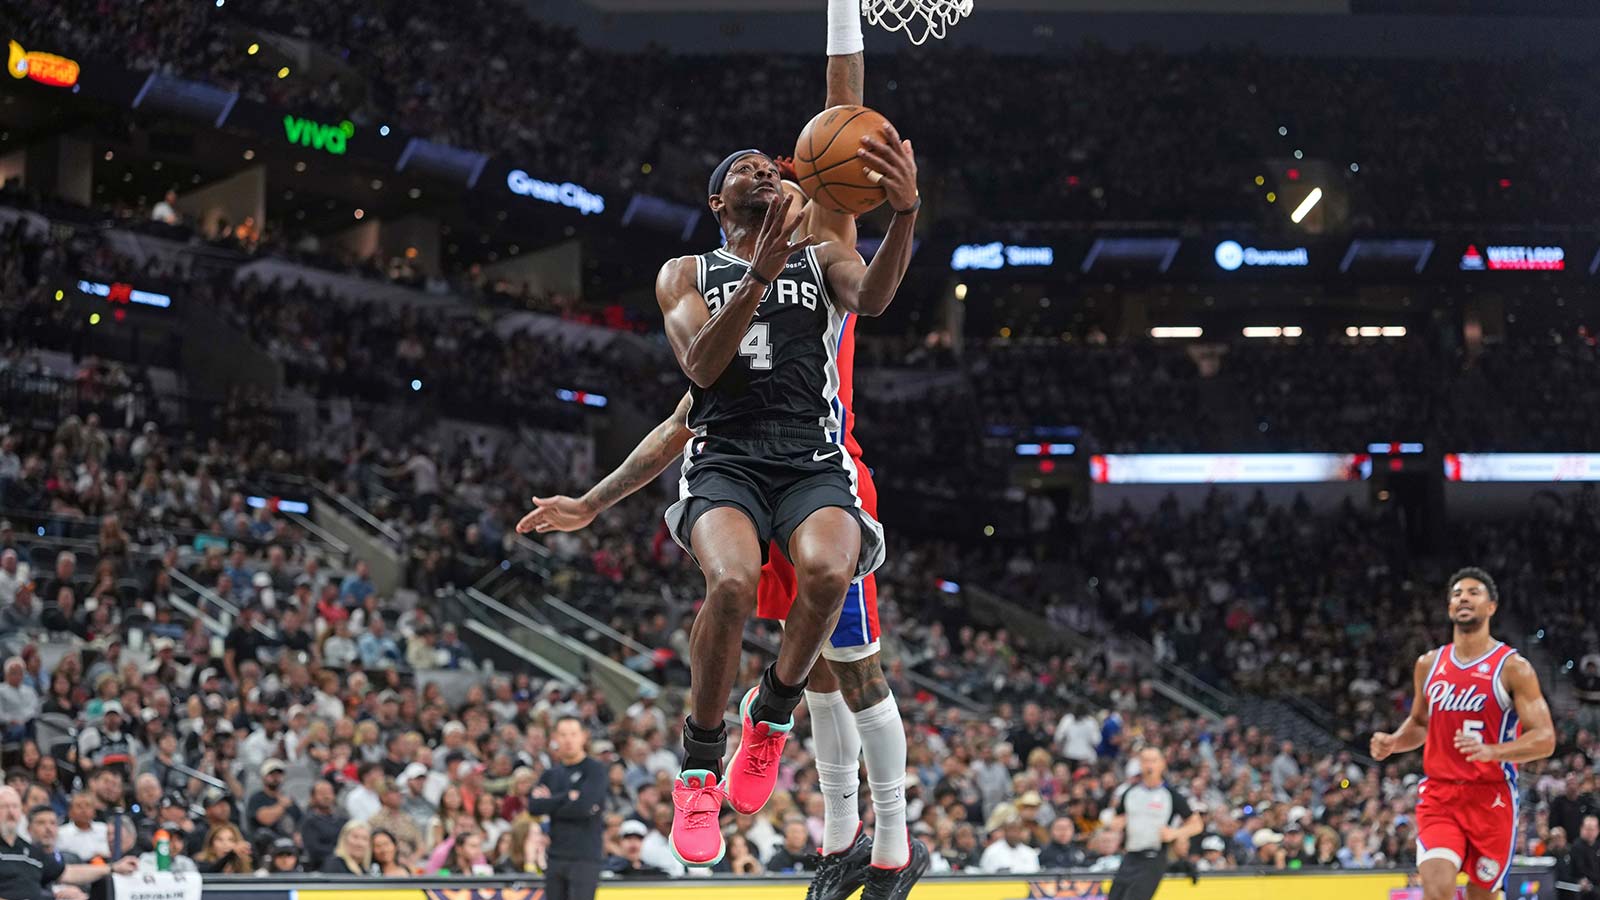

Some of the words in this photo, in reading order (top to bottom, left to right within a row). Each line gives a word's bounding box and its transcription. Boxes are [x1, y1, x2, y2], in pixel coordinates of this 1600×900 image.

[704, 279, 818, 316] SPRS
[738, 322, 773, 370] 4
[1427, 680, 1487, 716] Phila
[1463, 719, 1485, 745] 5
